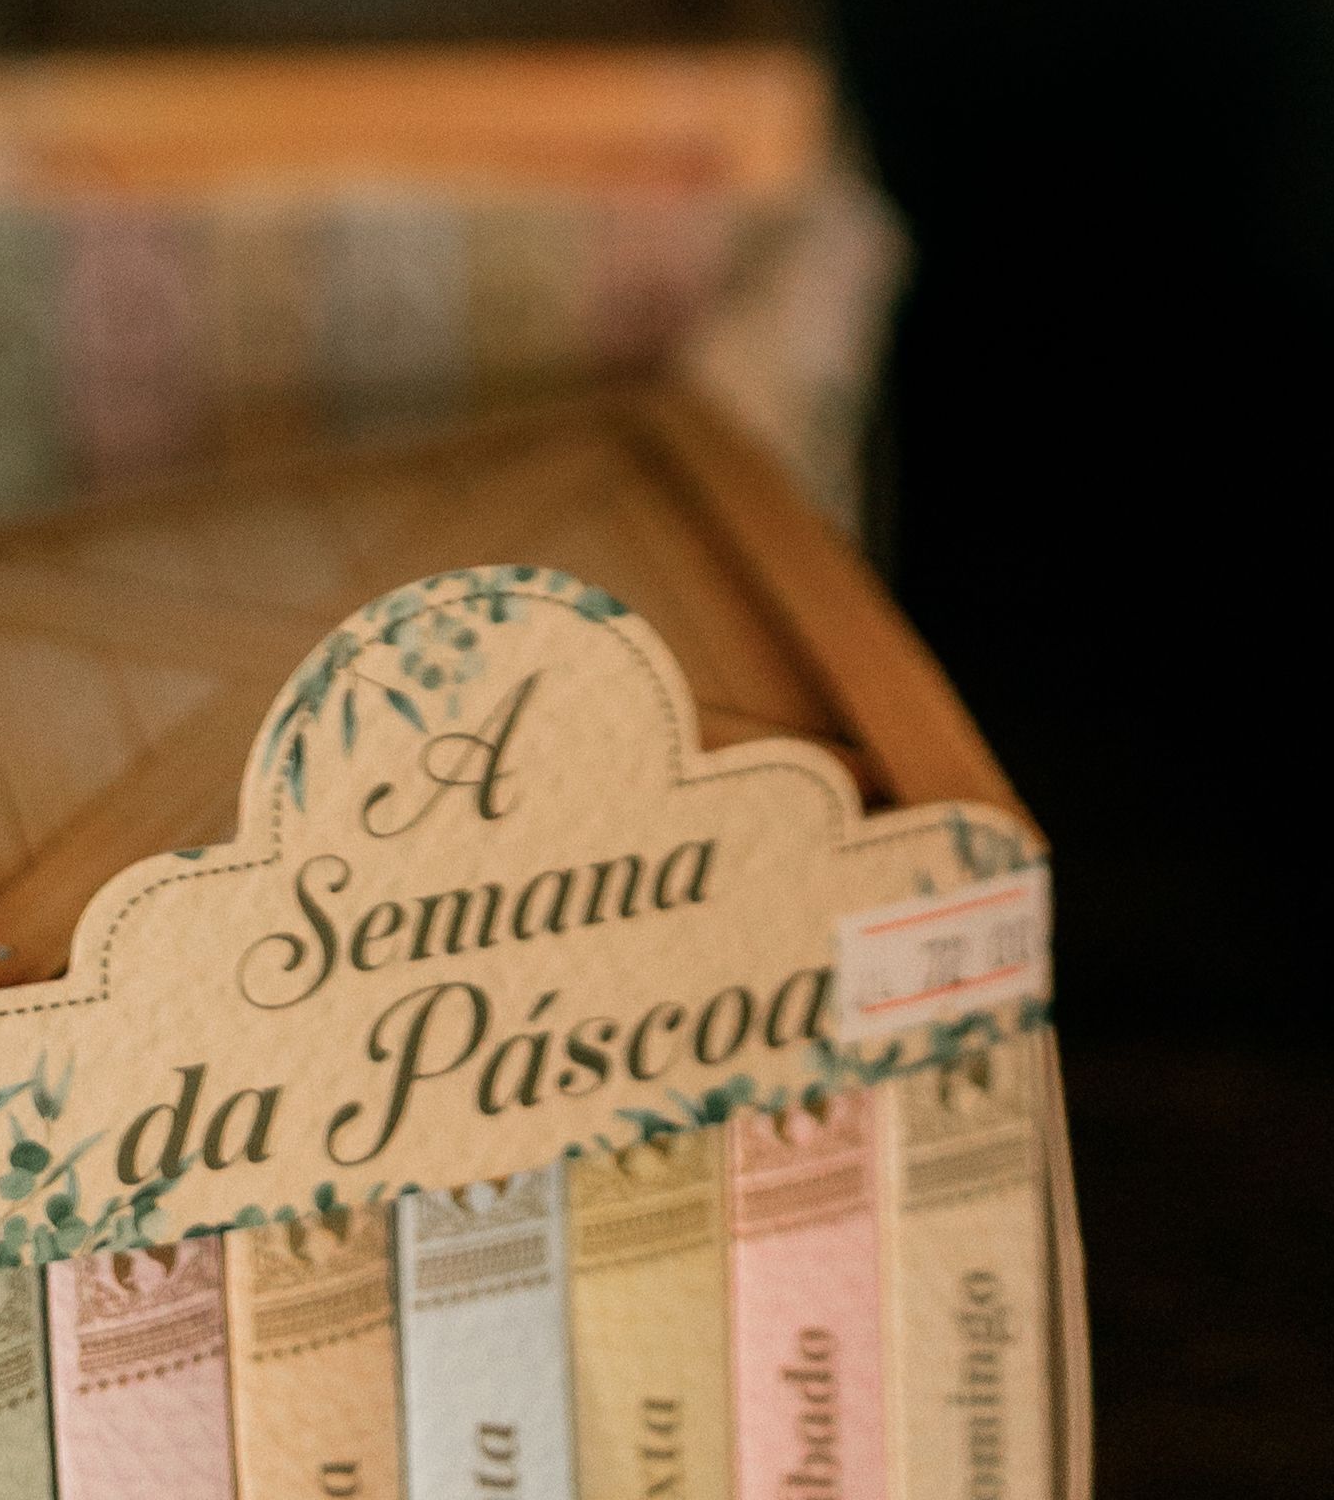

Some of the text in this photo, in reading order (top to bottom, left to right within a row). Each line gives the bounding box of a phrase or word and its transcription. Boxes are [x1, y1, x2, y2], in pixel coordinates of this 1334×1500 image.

[361, 668, 547, 839] A
[237, 839, 719, 1010] Semana
[115, 963, 839, 1186] da Páscoa
[780, 1325, 839, 1500] bado
